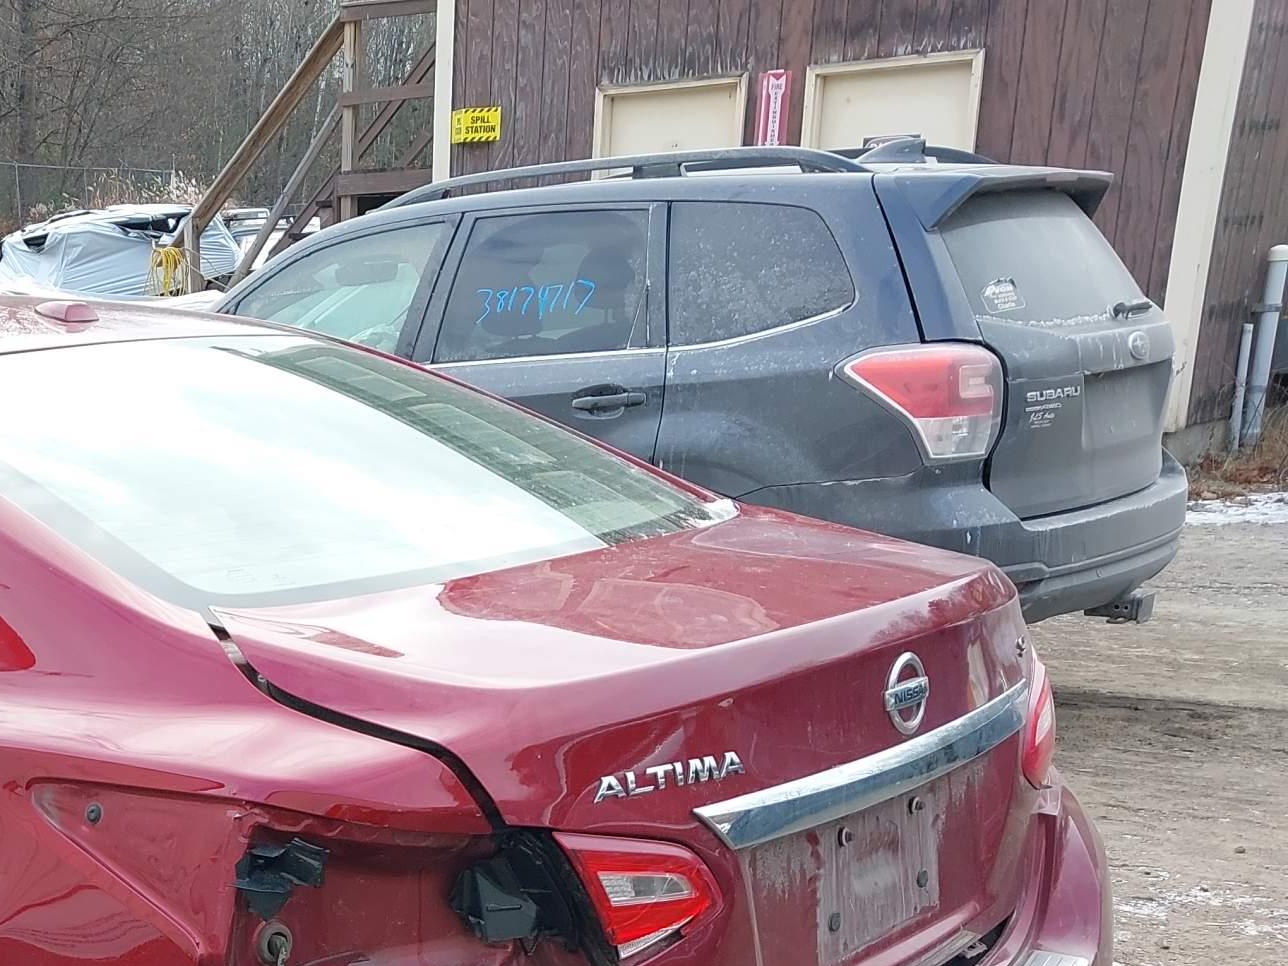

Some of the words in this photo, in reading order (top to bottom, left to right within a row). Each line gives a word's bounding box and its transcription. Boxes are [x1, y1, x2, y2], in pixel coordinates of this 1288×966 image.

[471, 115, 491, 125] SPILL
[465, 125, 497, 135] STATION
[1027, 386, 1081, 402] SUBARU
[593, 751, 746, 805] ALTIMA
